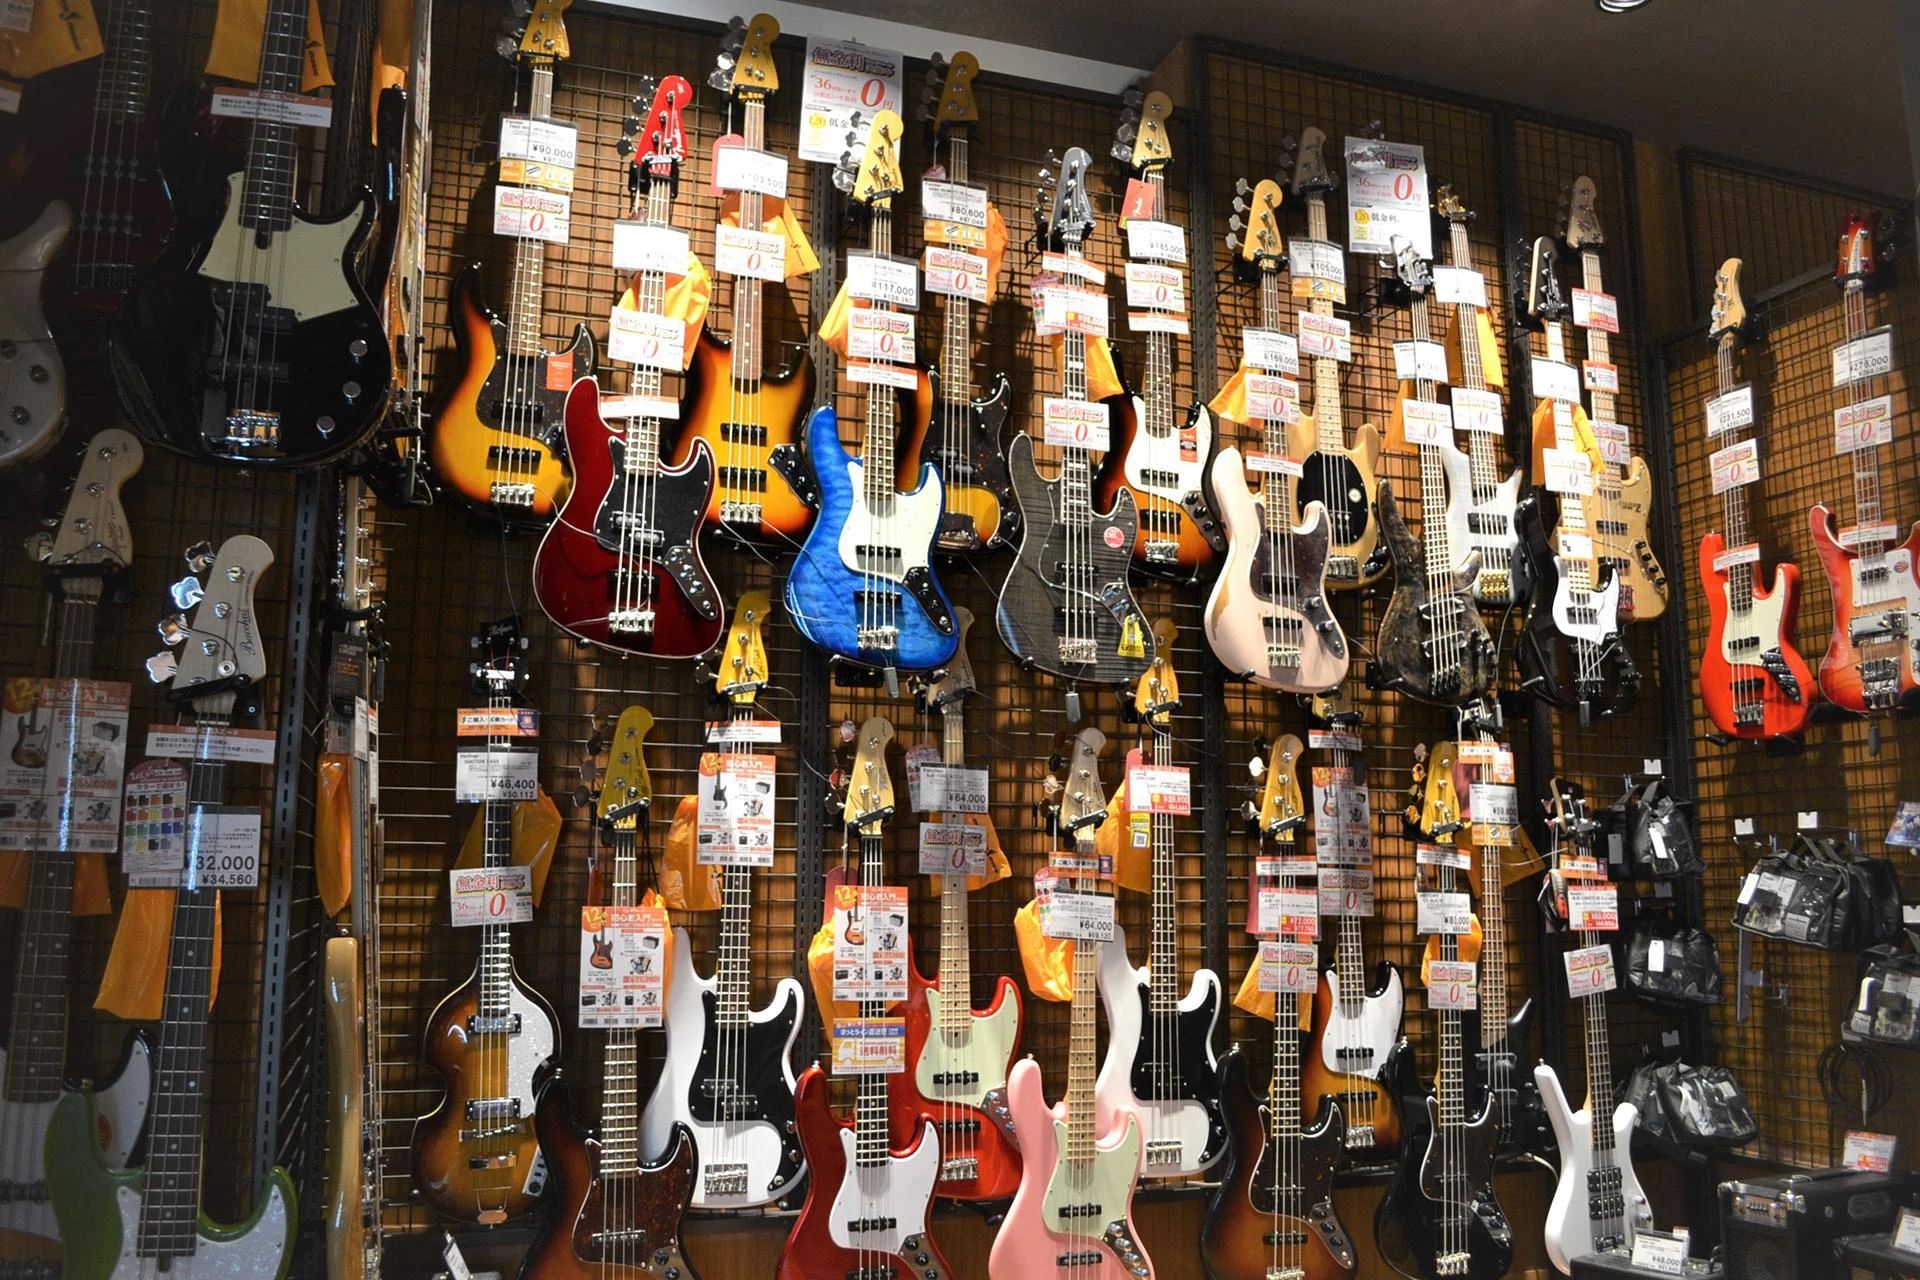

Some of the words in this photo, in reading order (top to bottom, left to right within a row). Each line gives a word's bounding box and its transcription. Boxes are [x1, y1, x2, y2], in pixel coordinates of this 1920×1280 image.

[45, 688, 107, 702] 初心入門
[951, 848, 965, 868] 0
[490, 893, 506, 916] 0
[1346, 890, 1357, 909] 0
[1287, 966, 1299, 986] 0
[1449, 983, 1460, 1003] 0
